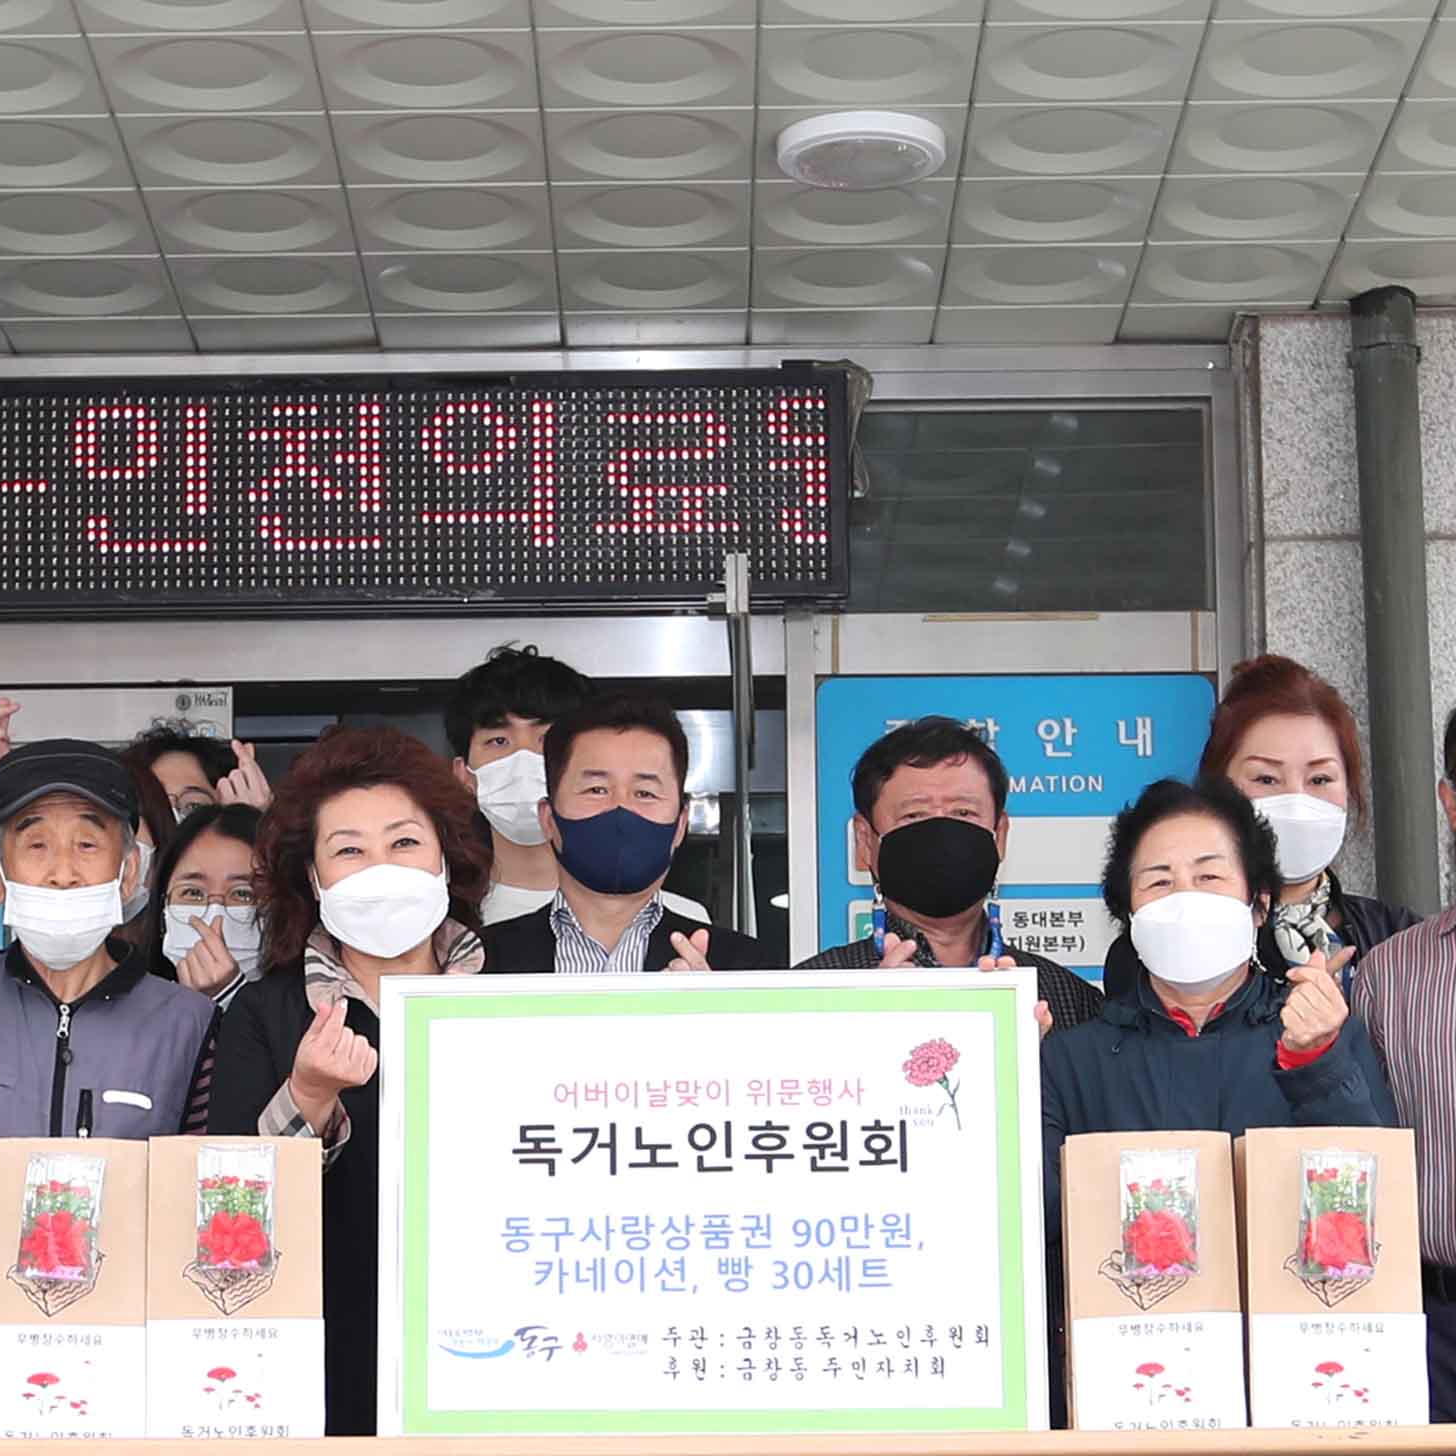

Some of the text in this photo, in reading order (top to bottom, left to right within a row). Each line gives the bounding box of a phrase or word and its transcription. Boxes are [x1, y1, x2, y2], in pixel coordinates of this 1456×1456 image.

[553, 1078, 865, 1109] 어버이날맞이 위문행사
[511, 1118, 910, 1178] 독거노인후원회
[500, 1212, 926, 1254] 동구사랑상품권 90만원,
[534, 1255, 894, 1296] 카네이션, 빵 30세트
